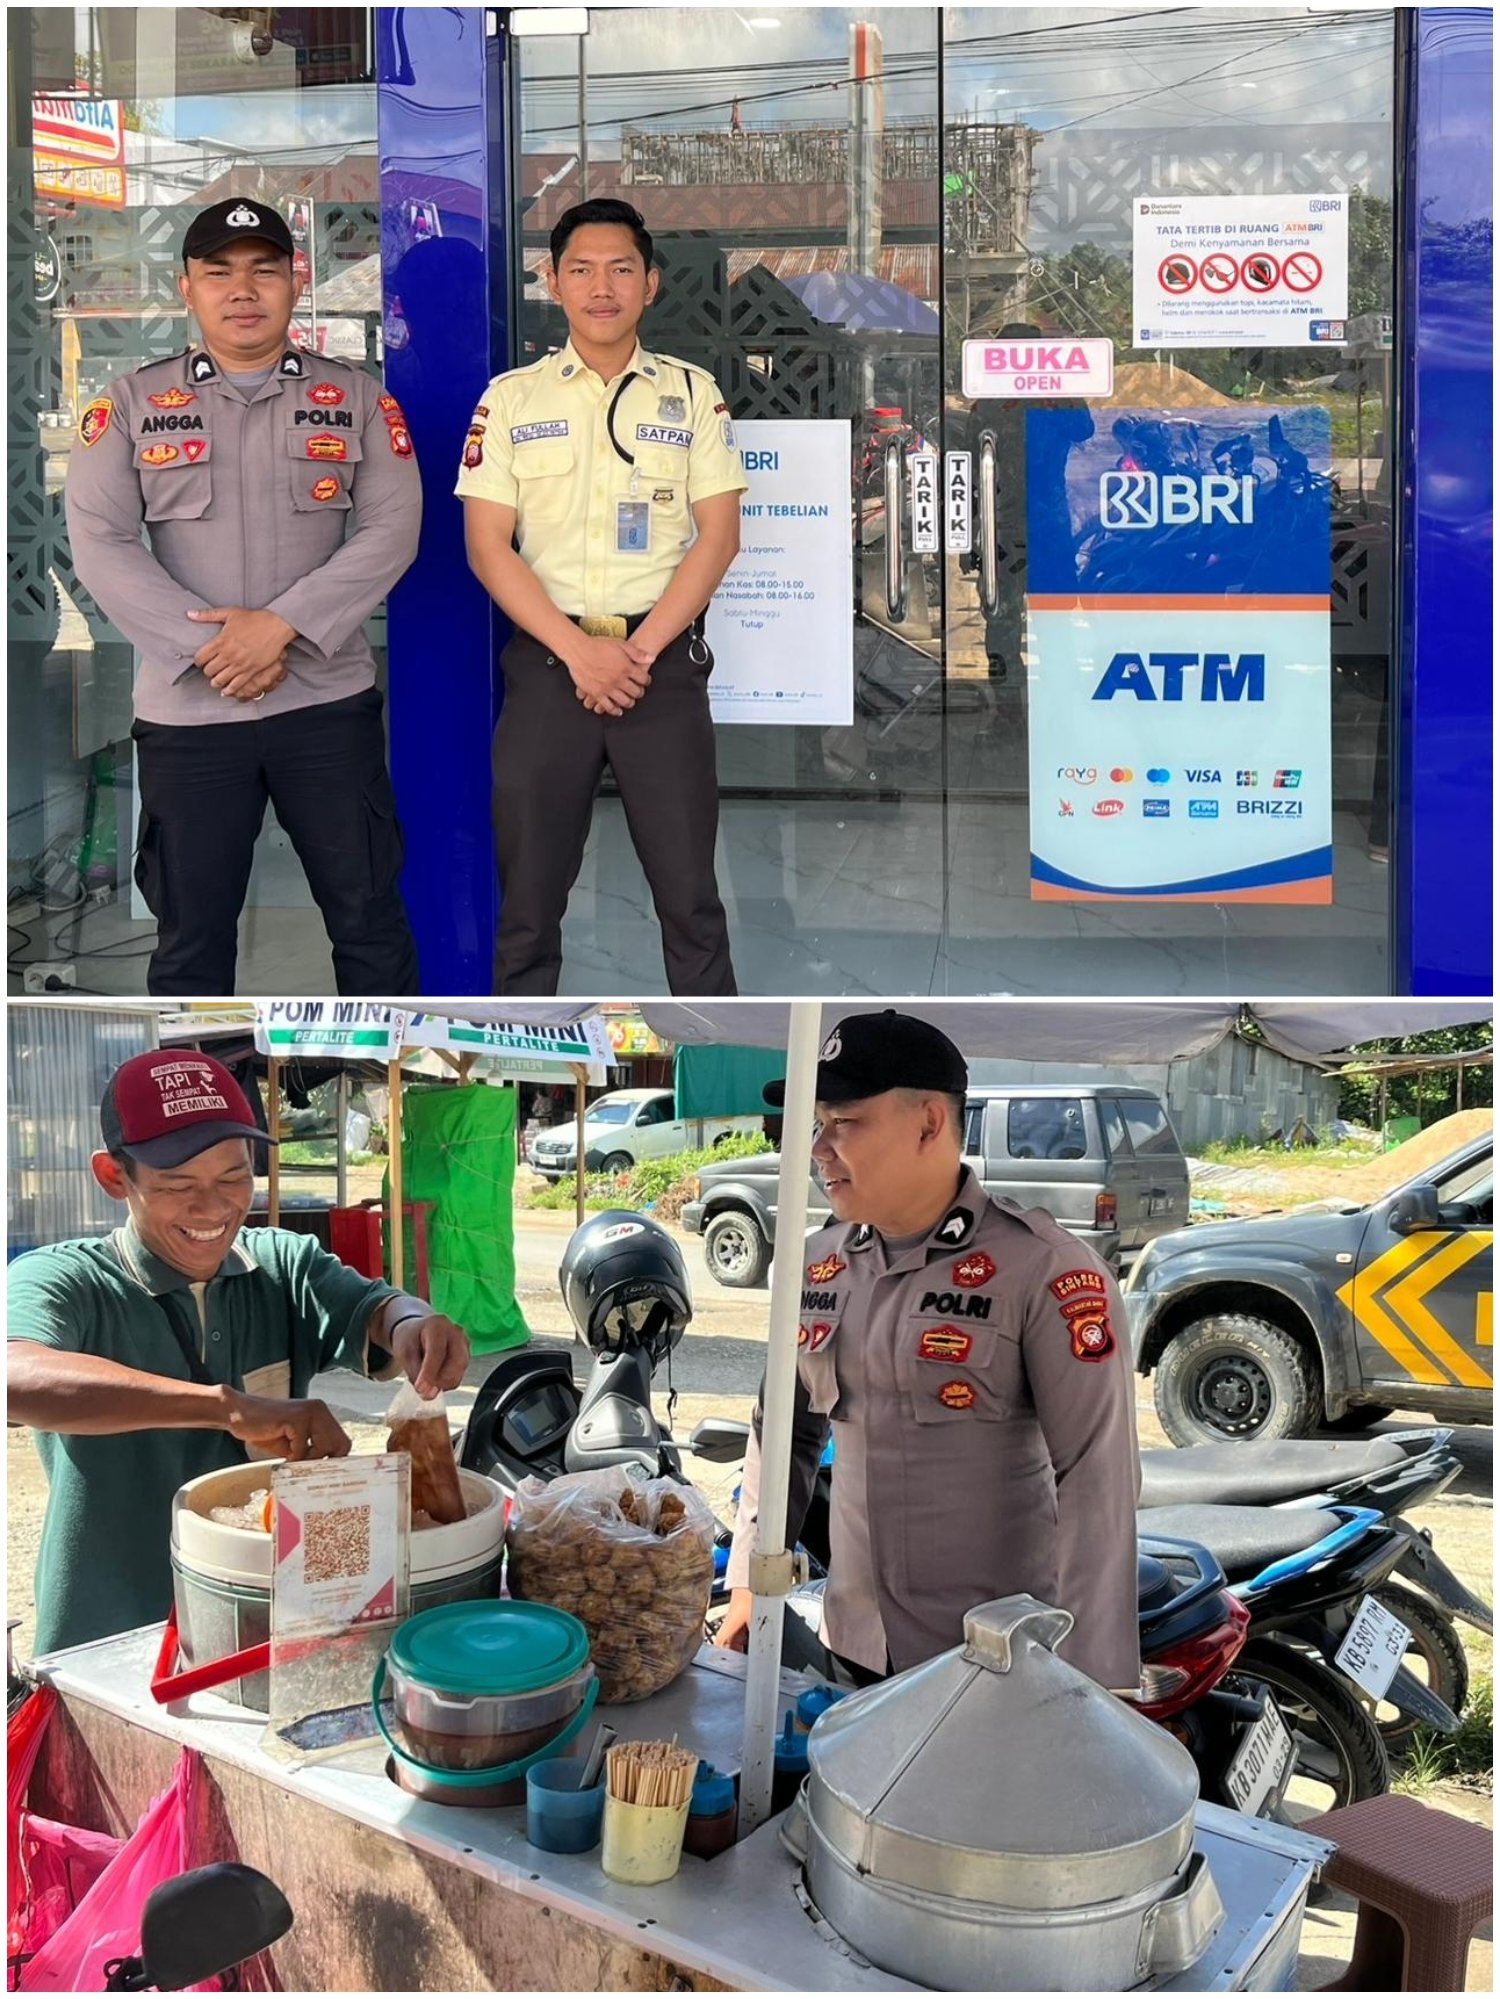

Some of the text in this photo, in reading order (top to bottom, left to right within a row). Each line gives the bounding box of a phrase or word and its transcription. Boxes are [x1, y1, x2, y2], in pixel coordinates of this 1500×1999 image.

[1322, 200, 1341, 212] BRI
[1156, 226, 1182, 235] TATA
[1187, 225, 1221, 234] TERTIB
[1224, 225, 1236, 233] DI
[1240, 224, 1279, 233] RUANG
[1170, 237, 1310, 250] Demi Kenyamanan Bersama
[1290, 307, 1308, 315] ATM
[984, 347, 1090, 370] BUKA
[1014, 376, 1062, 390] OPEN
[141, 415, 203, 434] ANGGA
[295, 410, 352, 428] POLRI
[745, 451, 779, 470] BRI
[916, 461, 933, 533] TARIK
[951, 459, 966, 532] TARIK
[1162, 474, 1254, 524] BRI
[742, 505, 829, 517] NIT TEBELIAN
[741, 620, 763, 629] Tutup
[1091, 652, 1265, 701] ATM
[1185, 769, 1222, 783] VISA
[1236, 800, 1302, 814] BRIZZI
[269, 1002, 324, 1023] POM
[294, 1030, 354, 1044] PERTALITE
[483, 1033, 559, 1052] PERTALITE
[154, 1073, 192, 1091] TAPI
[161, 1087, 201, 1102] TAK SEMPAT
[168, 1097, 225, 1115] MEMILIKI
[605, 1226, 634, 1239] GM
[800, 1291, 837, 1311] NGGA
[919, 1292, 992, 1319] POLRI
[1343, 1601, 1387, 1674] KB 5897 RM
[1231, 1702, 1280, 1807] KB 3071 MAE
